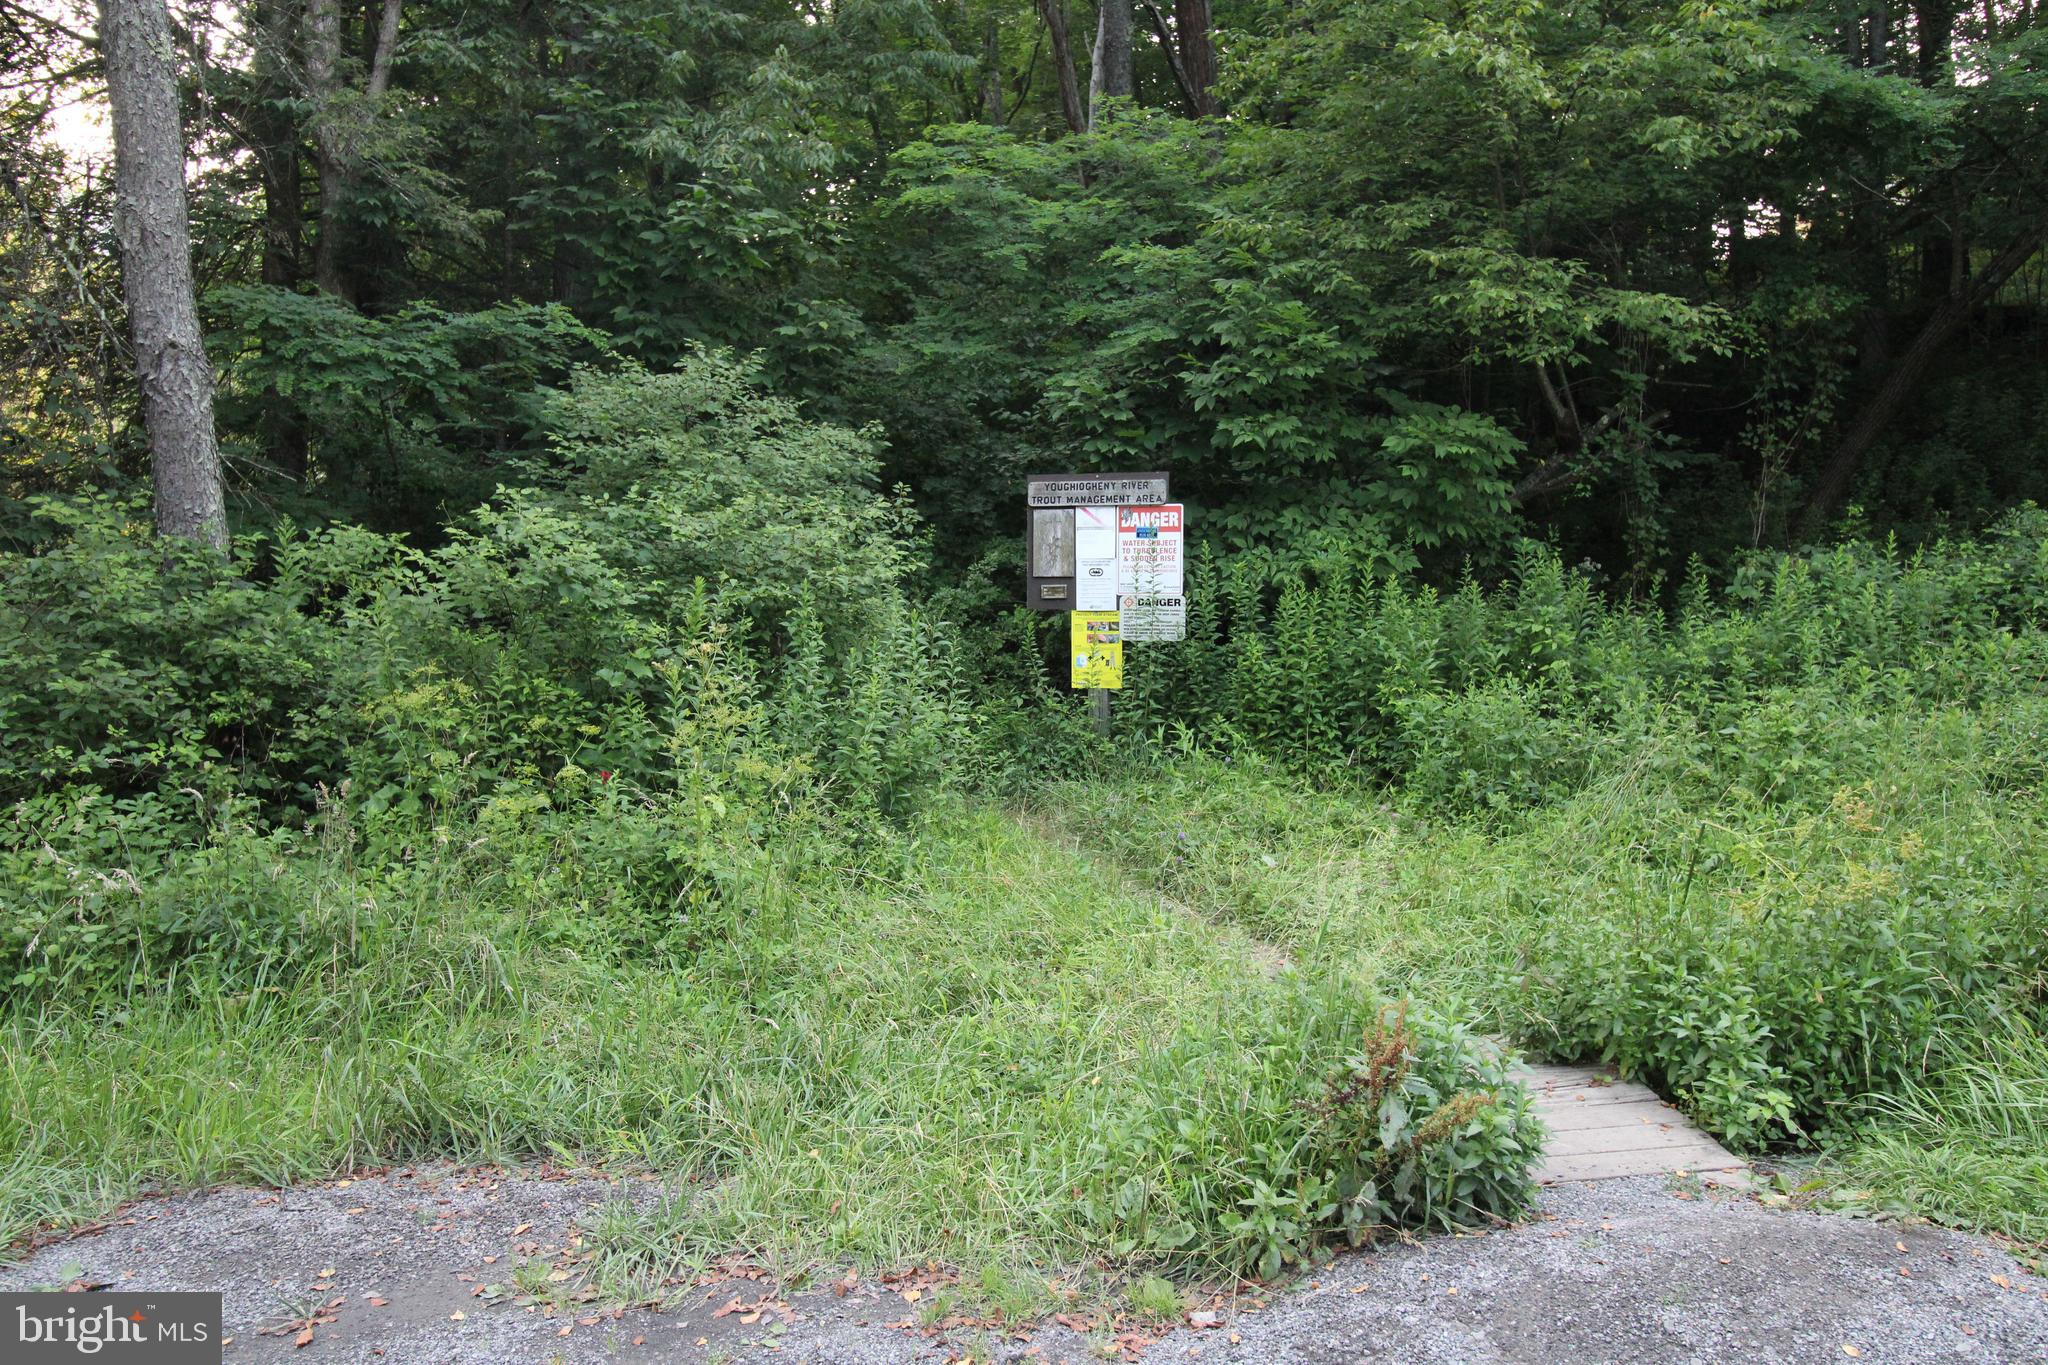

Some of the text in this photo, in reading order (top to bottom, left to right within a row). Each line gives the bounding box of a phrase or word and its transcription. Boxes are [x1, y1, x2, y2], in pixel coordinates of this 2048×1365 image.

[1044, 481, 1149, 491] YOUGHIOGHENY RIVER
[1031, 494, 1162, 504] TROUT MANAGEMENT AREA
[1121, 510, 1179, 528] DANGER
